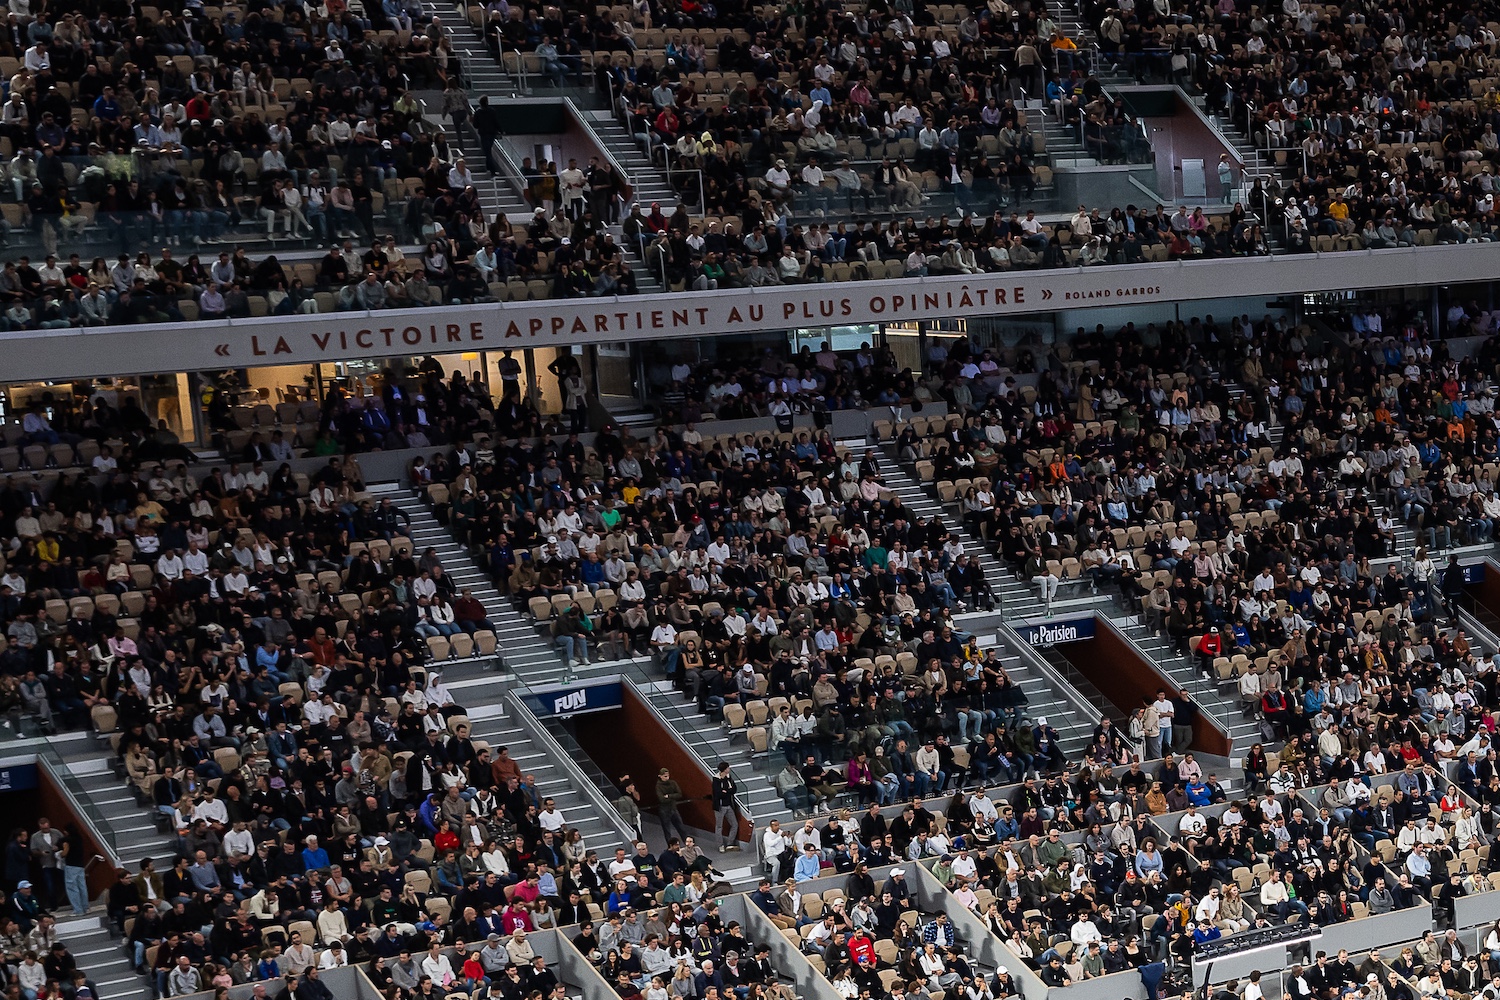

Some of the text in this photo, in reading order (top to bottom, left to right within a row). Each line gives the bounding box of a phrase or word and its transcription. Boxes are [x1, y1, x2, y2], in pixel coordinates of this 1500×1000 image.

[1065, 286, 1161, 300] ROLAND GARROS
[251, 335, 293, 356] LA
[311, 322, 484, 351] VICTOIRE
[504, 307, 708, 338] APPARTIENT
[727, 304, 764, 324] AU
[783, 298, 852, 319] PLUS
[869, 285, 1026, 314] OPINIÂTRE
[1039, 624, 1077, 643] Parisien
[554, 688, 587, 713] FUN
